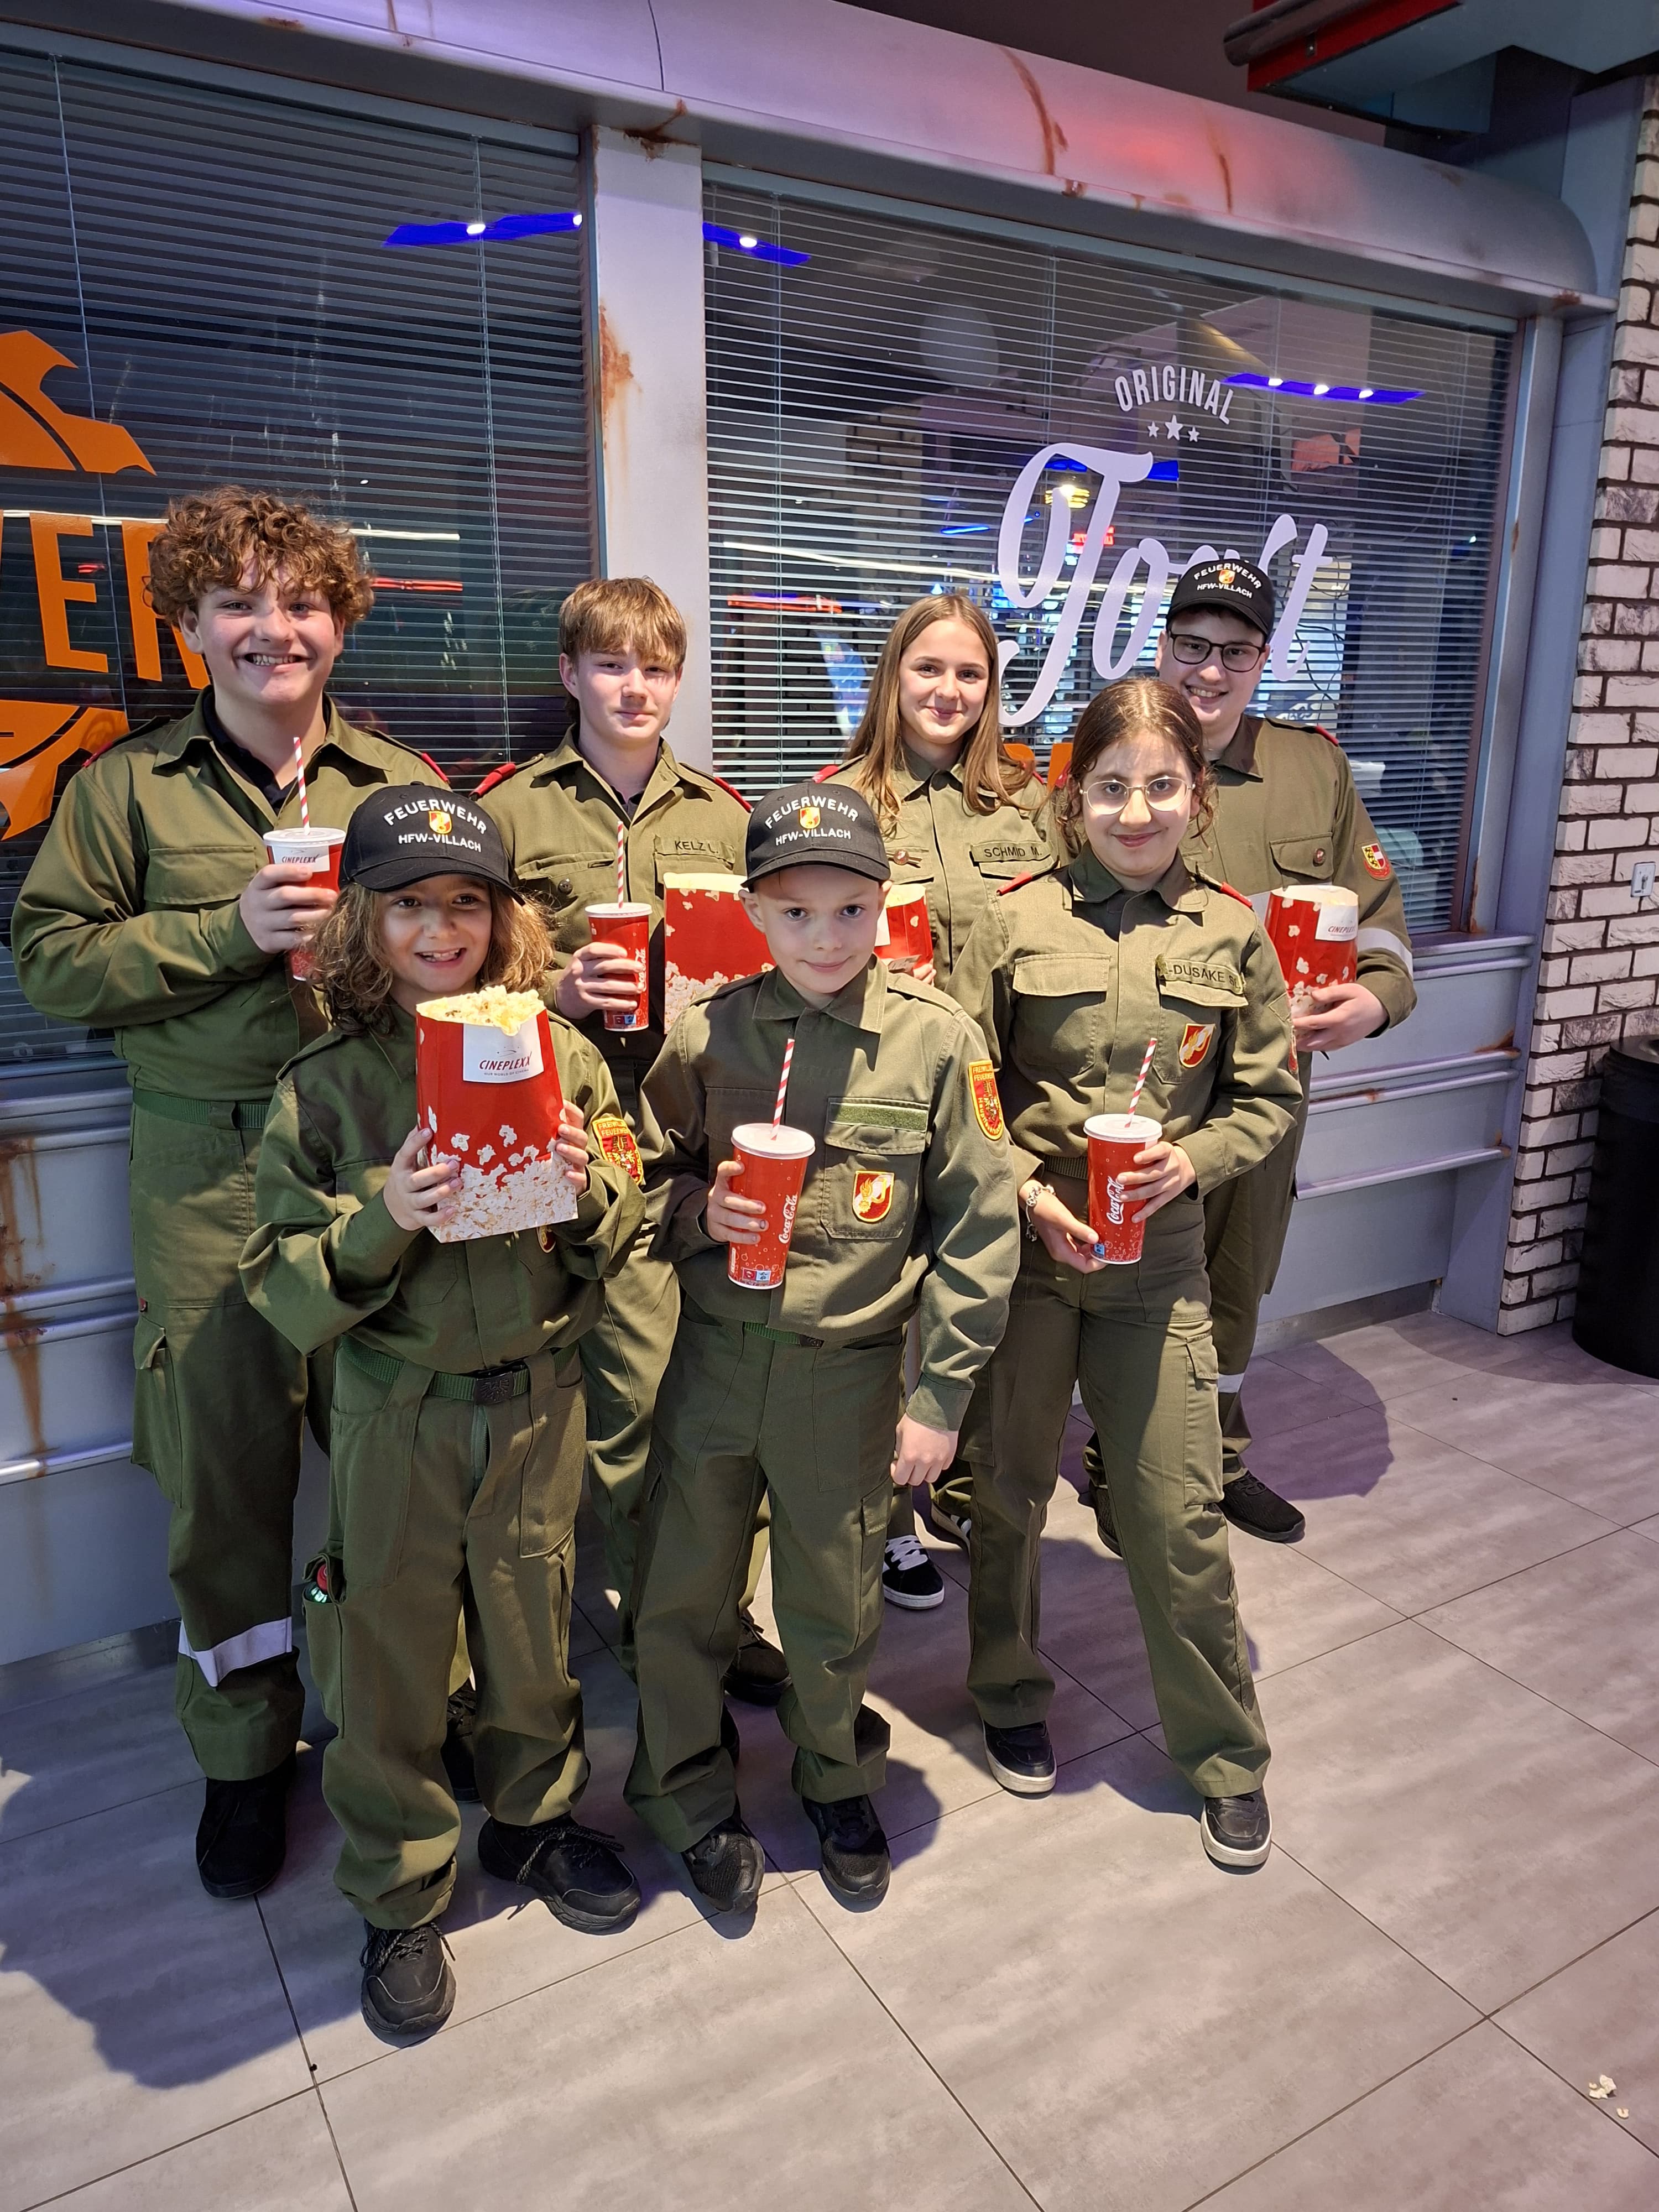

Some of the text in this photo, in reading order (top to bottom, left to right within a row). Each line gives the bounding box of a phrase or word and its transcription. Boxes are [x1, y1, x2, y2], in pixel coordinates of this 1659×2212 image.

[1114, 365, 1234, 425] ORIGINAL
[997, 443, 1333, 726] Tot
[1193, 562, 1262, 589] FEUERWEHR
[0, 509, 211, 690] ER
[1197, 582, 1253, 599] HFW-VILLACH
[383, 799, 487, 834] FEUERWEHR
[765, 795, 858, 830] FEUERWEHR
[398, 833, 482, 853] HFW-VILLACH
[675, 840, 706, 852] KELZ
[775, 828, 852, 846] HFW-VILLACH
[281, 854, 320, 863] CINEPLEXX
[984, 846, 1042, 858] SCHMID M.
[479, 1051, 532, 1071] CINEPLEXX
[779, 1191, 798, 1244] Coca-Cola
